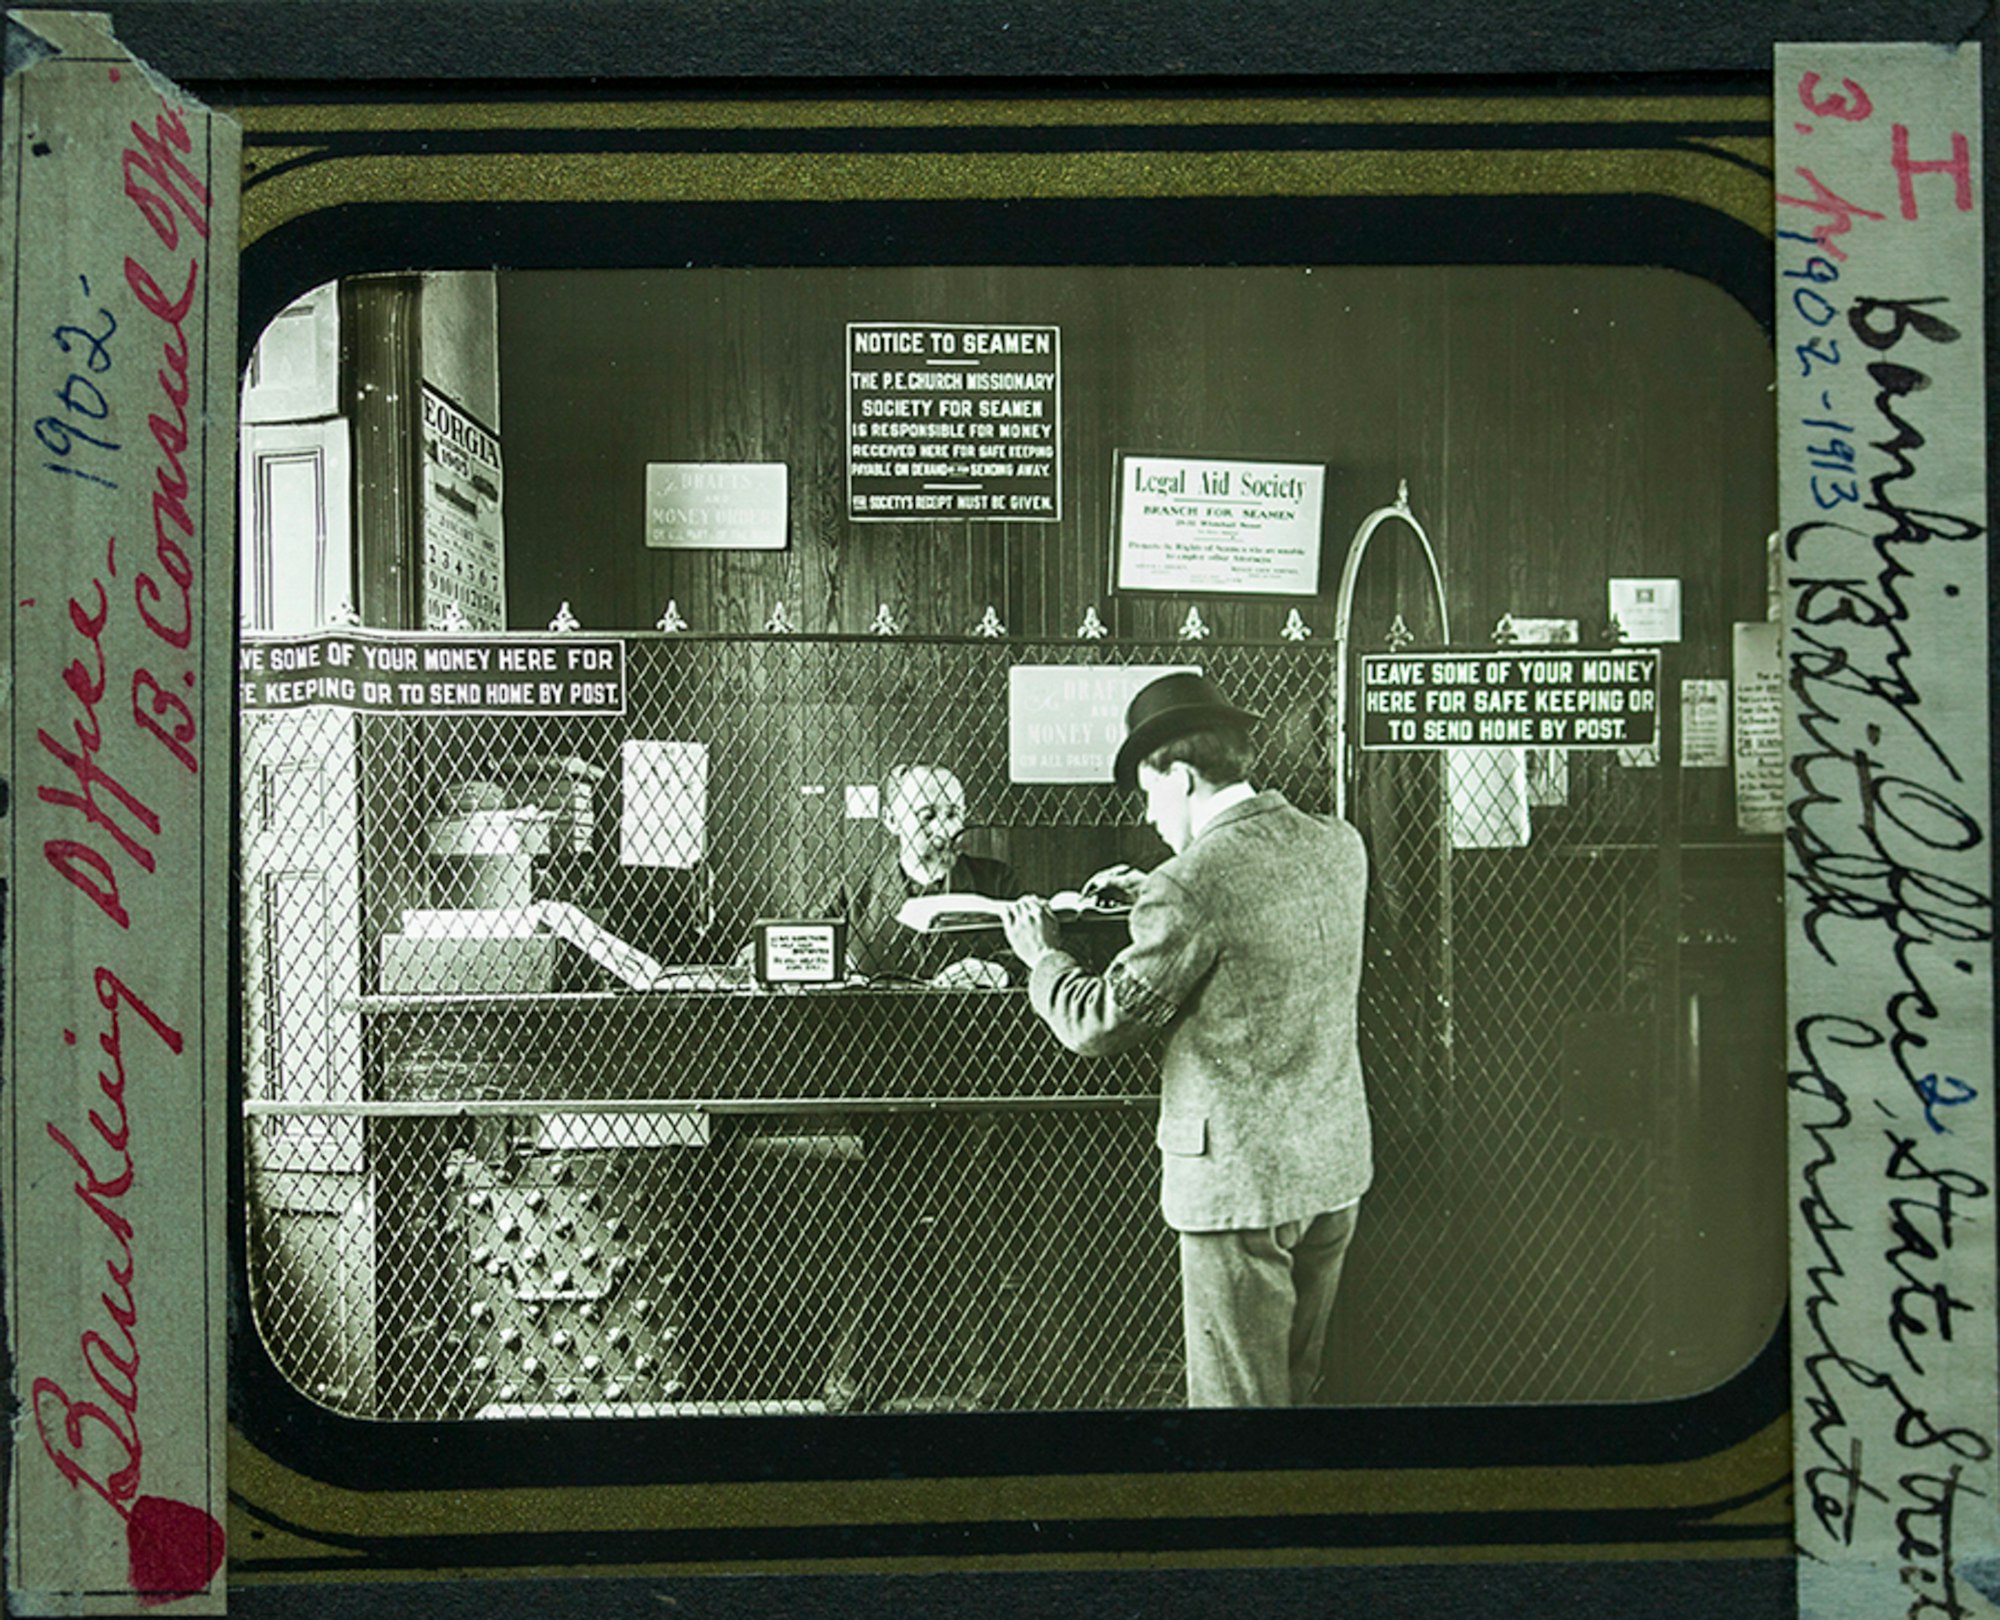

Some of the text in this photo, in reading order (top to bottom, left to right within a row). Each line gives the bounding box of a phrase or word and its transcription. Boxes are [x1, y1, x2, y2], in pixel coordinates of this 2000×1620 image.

[855, 332, 1050, 354] NOTICE TO SEAMEN
[851, 373, 879, 390] THE
[966, 373, 1054, 391] MISSIONARY
[862, 401, 1043, 417] SOCIETY FOR SEAMEN
[424, 396, 501, 470] EORGIA
[852, 424, 1051, 439] IS RESPONSIBLE FOR MONEY
[124, 255, 199, 650] Consul
[852, 444, 917, 458] RECEIVED
[952, 444, 976, 458] FOR
[1135, 466, 1307, 505] Legal Aid Society
[991, 495, 1006, 510] BE
[1143, 505, 1295, 520] BRANCH FOR SEAMEN
[652, 508, 708, 524] MONEY
[1800, 297, 1985, 783] Banking
[429, 544, 437, 565] 2
[442, 550, 450, 570] 3
[479, 568, 488, 588] 6
[491, 574, 499, 593] 7
[429, 569, 438, 590] 9
[271, 645, 321, 670] SOME
[327, 642, 355, 666] OF
[362, 646, 418, 671] YOUR
[424, 648, 490, 671] MONEY
[499, 648, 557, 671] HERE
[568, 649, 614, 670] FOR
[1367, 660, 1655, 685] LEAVE SOME OF YOUR MONEY
[265, 677, 356, 704] KEEPING
[362, 681, 392, 704] OR
[399, 683, 424, 705] TO
[430, 684, 480, 704] SEND
[486, 684, 533, 704] HOME
[539, 684, 562, 705] BY
[569, 683, 619, 704] POST.
[1367, 689, 1655, 713] HERE FOR SAFE KEEPING OR
[1026, 723, 1094, 745] MONEY
[1388, 718, 1627, 741] TO SEND HOME BY POST.
[33, 966, 183, 1524] Banking
[1884, 1129, 1990, 1376] State
